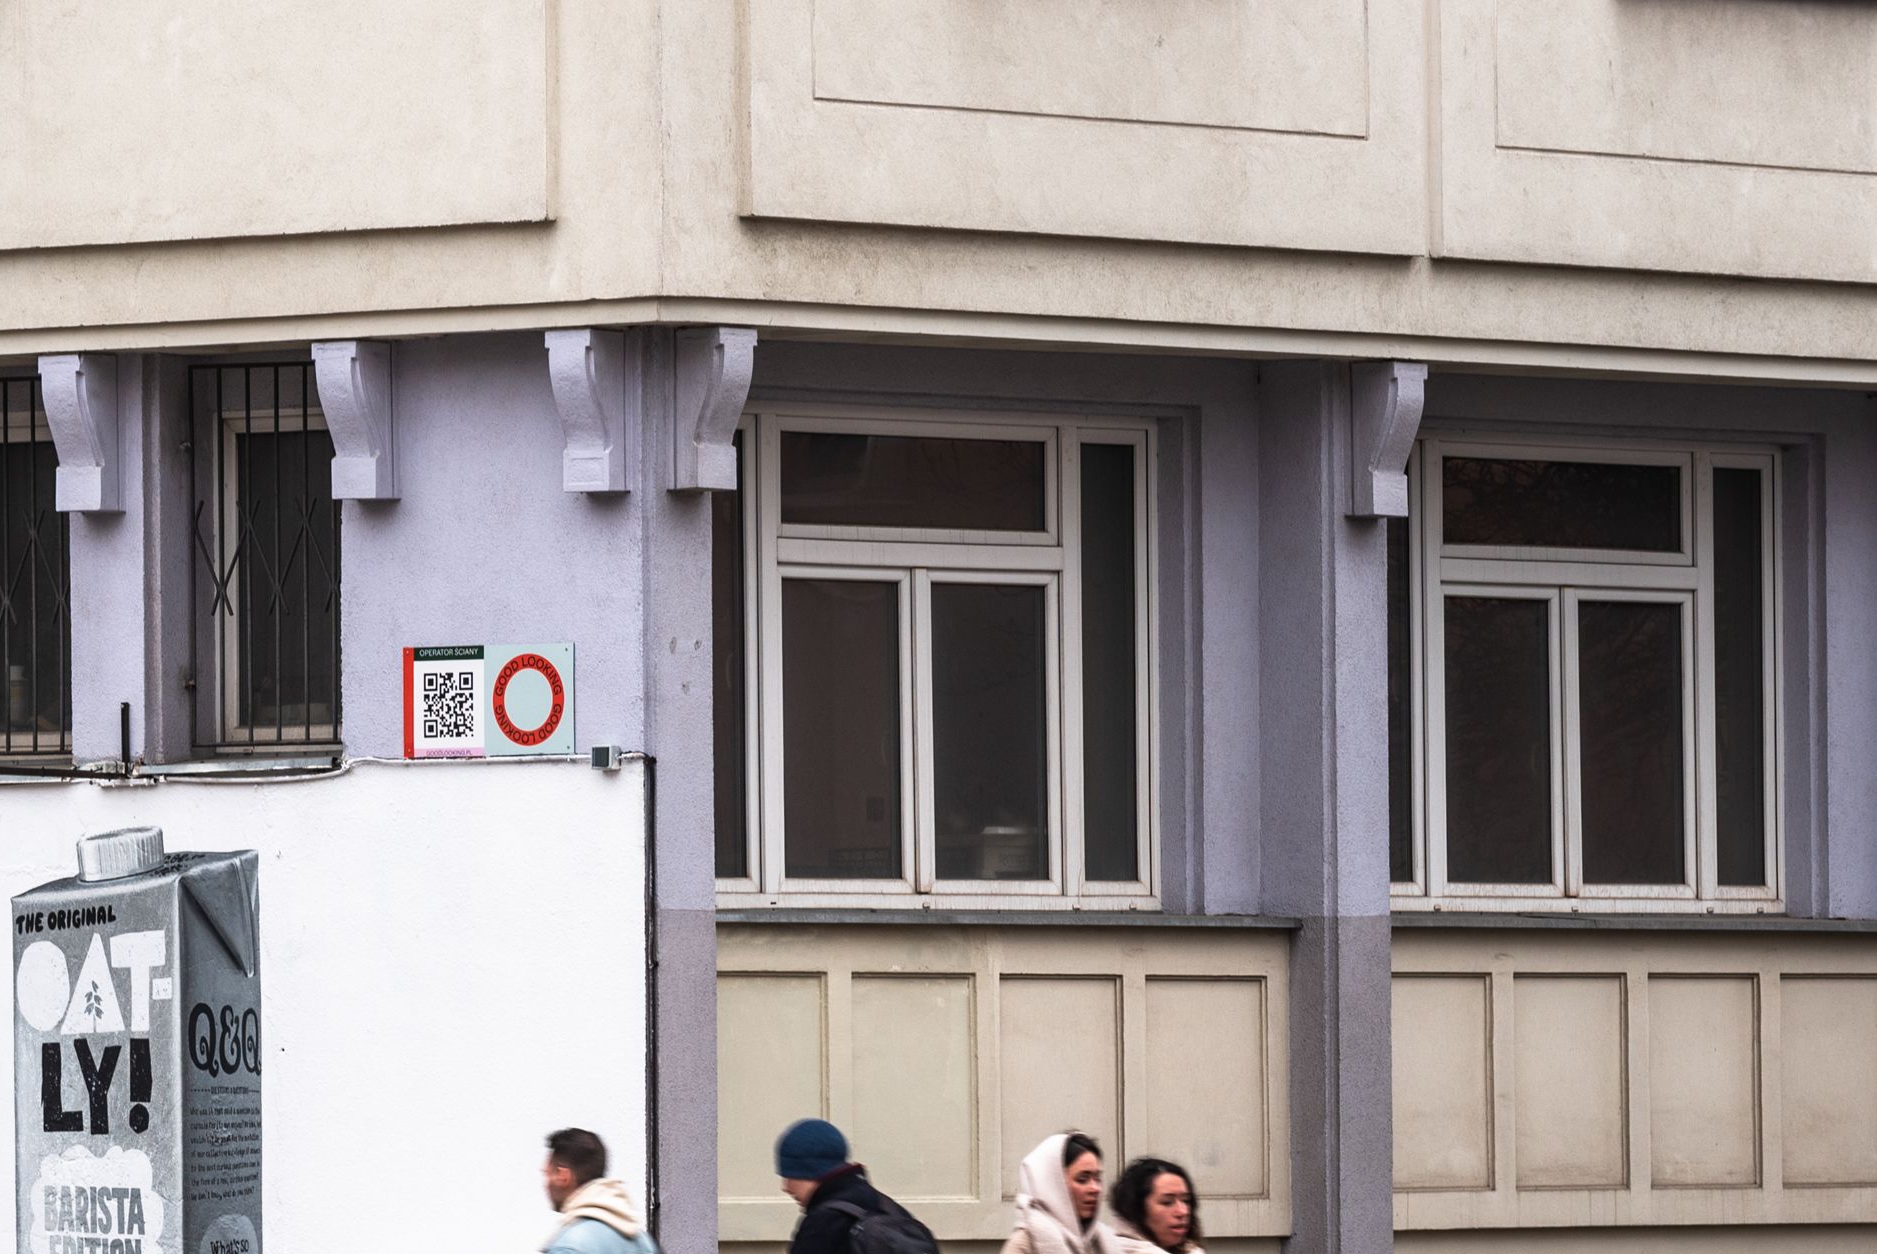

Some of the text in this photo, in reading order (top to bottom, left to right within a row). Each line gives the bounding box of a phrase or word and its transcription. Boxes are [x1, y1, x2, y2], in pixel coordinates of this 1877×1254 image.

[419, 648, 454, 657] OPERATOR
[495, 656, 562, 697] GOOD LOOKING
[495, 703, 562, 744] GOOD LOOKING
[15, 905, 117, 935] THE ORIGINAL
[41, 1037, 153, 1135] LY!
[43, 1185, 146, 1235] BARISTA
[240, 1239, 250, 1253] so
